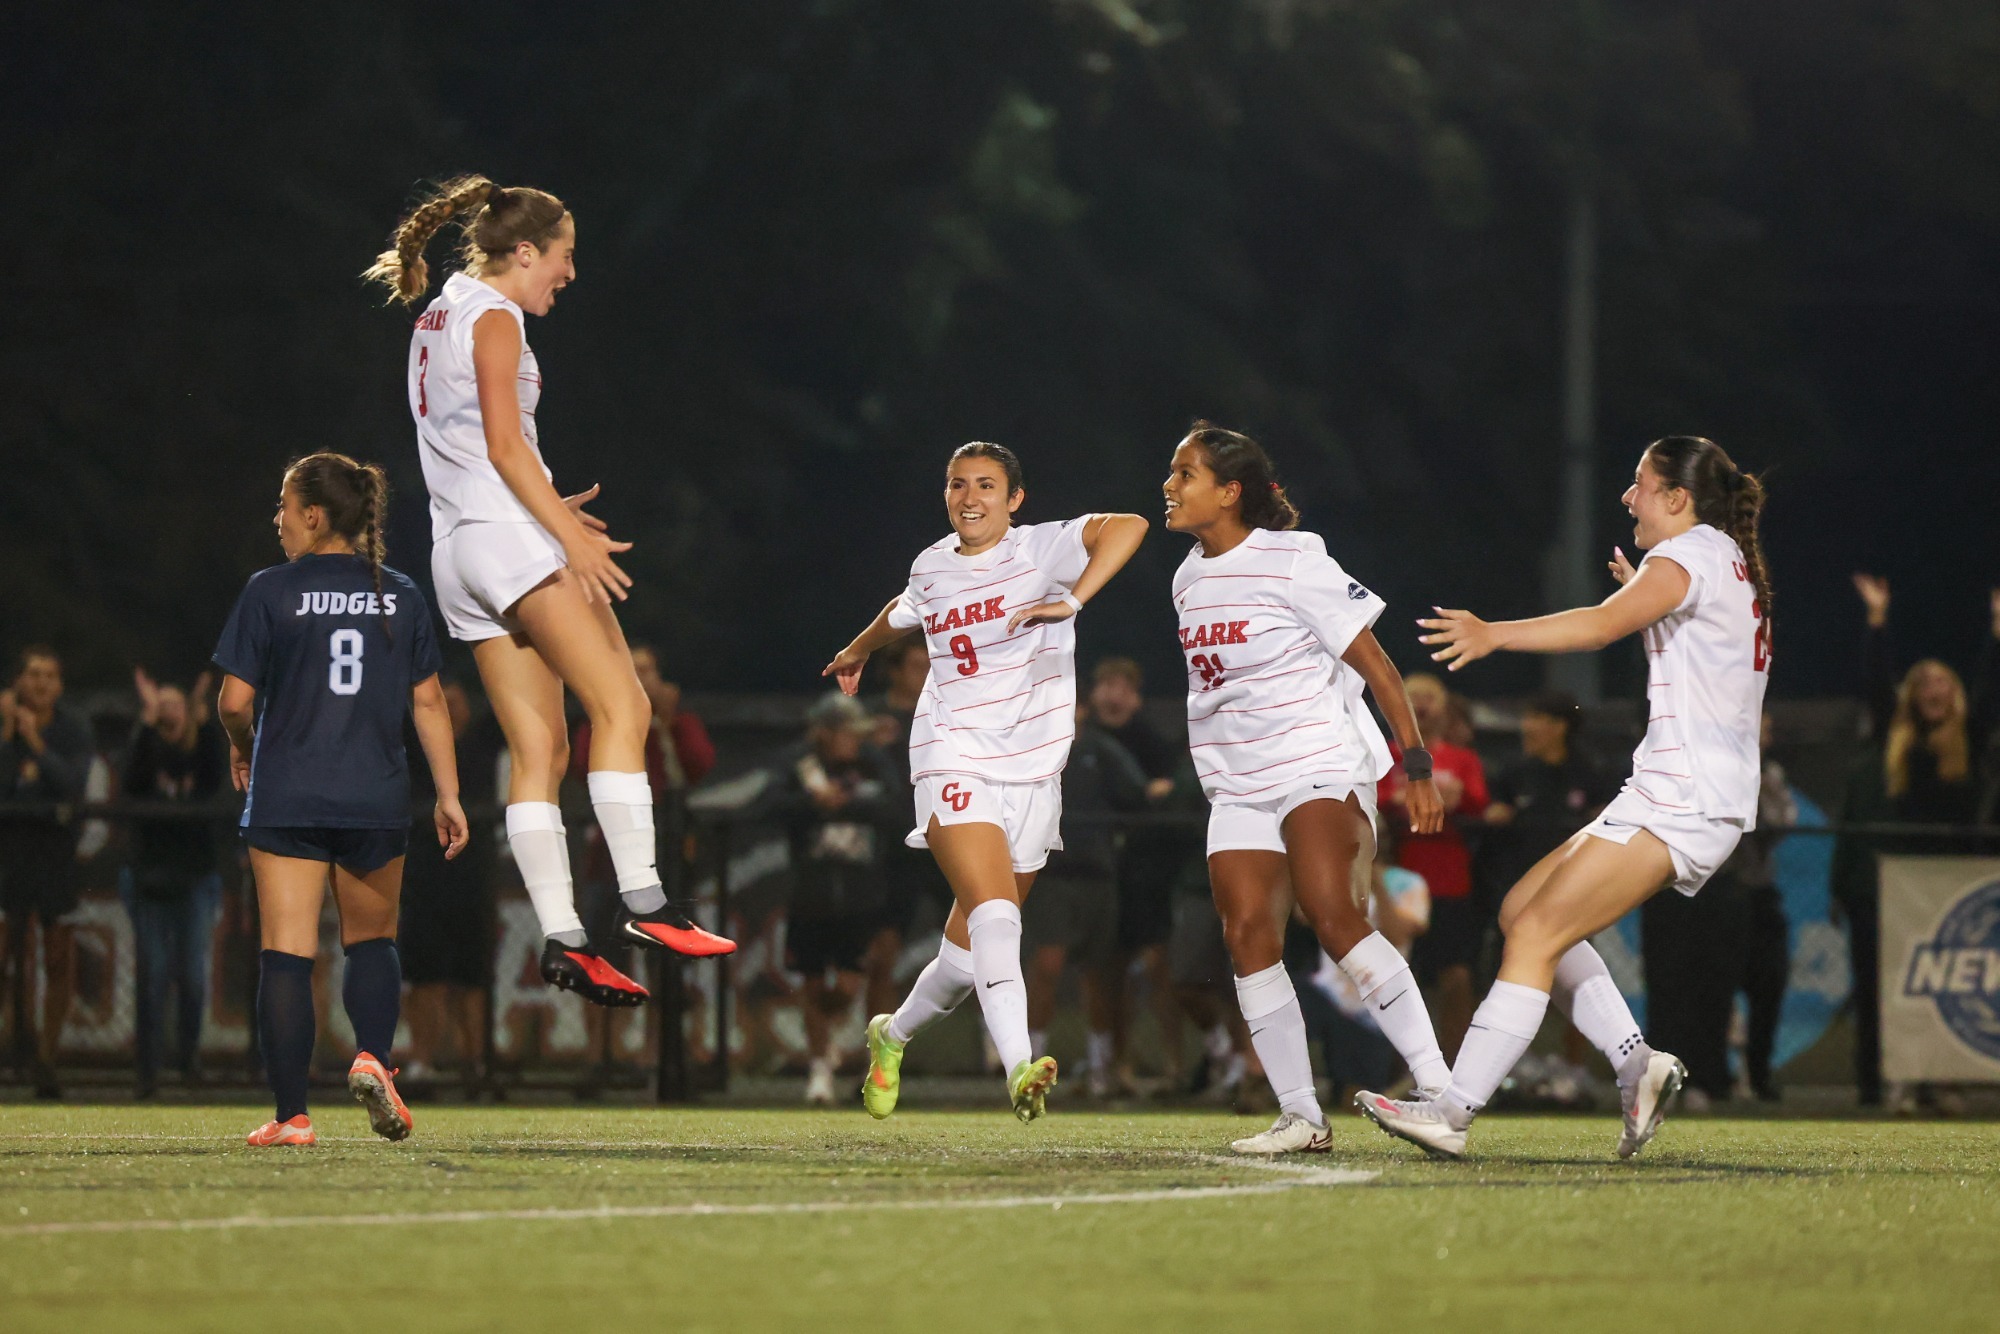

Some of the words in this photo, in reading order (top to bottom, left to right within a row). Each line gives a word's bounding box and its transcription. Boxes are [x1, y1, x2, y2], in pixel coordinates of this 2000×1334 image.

[296, 591, 398, 616] JUDGES
[1178, 620, 1249, 651] LARK
[329, 628, 364, 695] 8
[949, 634, 979, 676] 9
